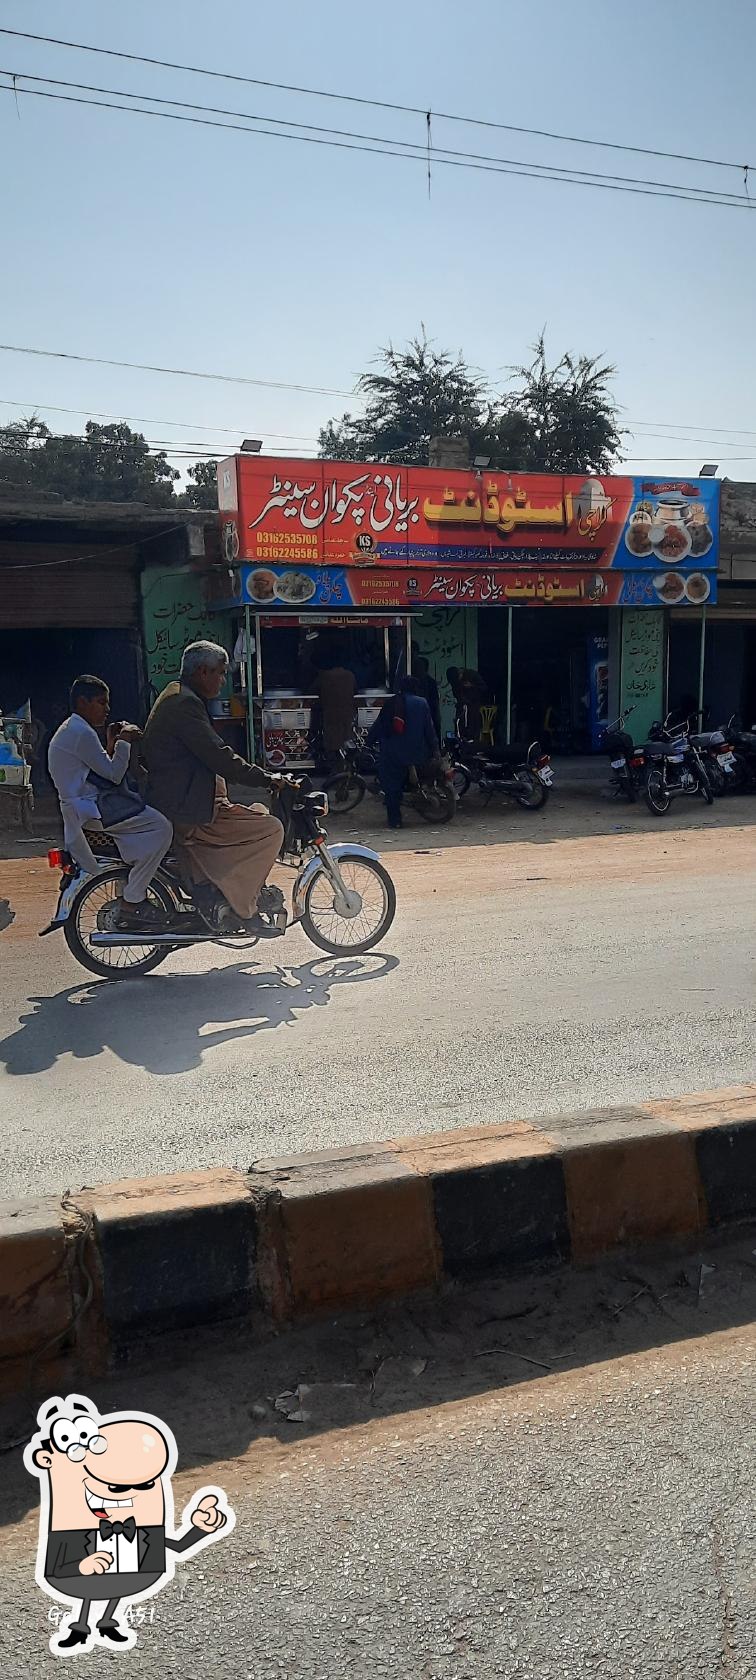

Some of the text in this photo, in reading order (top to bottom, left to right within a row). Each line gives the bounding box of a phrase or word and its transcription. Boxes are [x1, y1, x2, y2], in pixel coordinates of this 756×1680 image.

[249, 475, 316, 529] سینٹر
[300, 473, 372, 529] پکوان
[369, 473, 419, 532] بریانی
[424, 480, 573, 532] اسٹوڈنٹ
[577, 497, 617, 540] کراچی
[256, 546, 318, 559] 03162245586
[359, 535, 371, 547] KS
[424, 573, 453, 599] سینٹر
[445, 574, 478, 600] پکوان
[480, 573, 504, 600] بریانی
[505, 573, 584, 601] اسٹوڈنٹ
